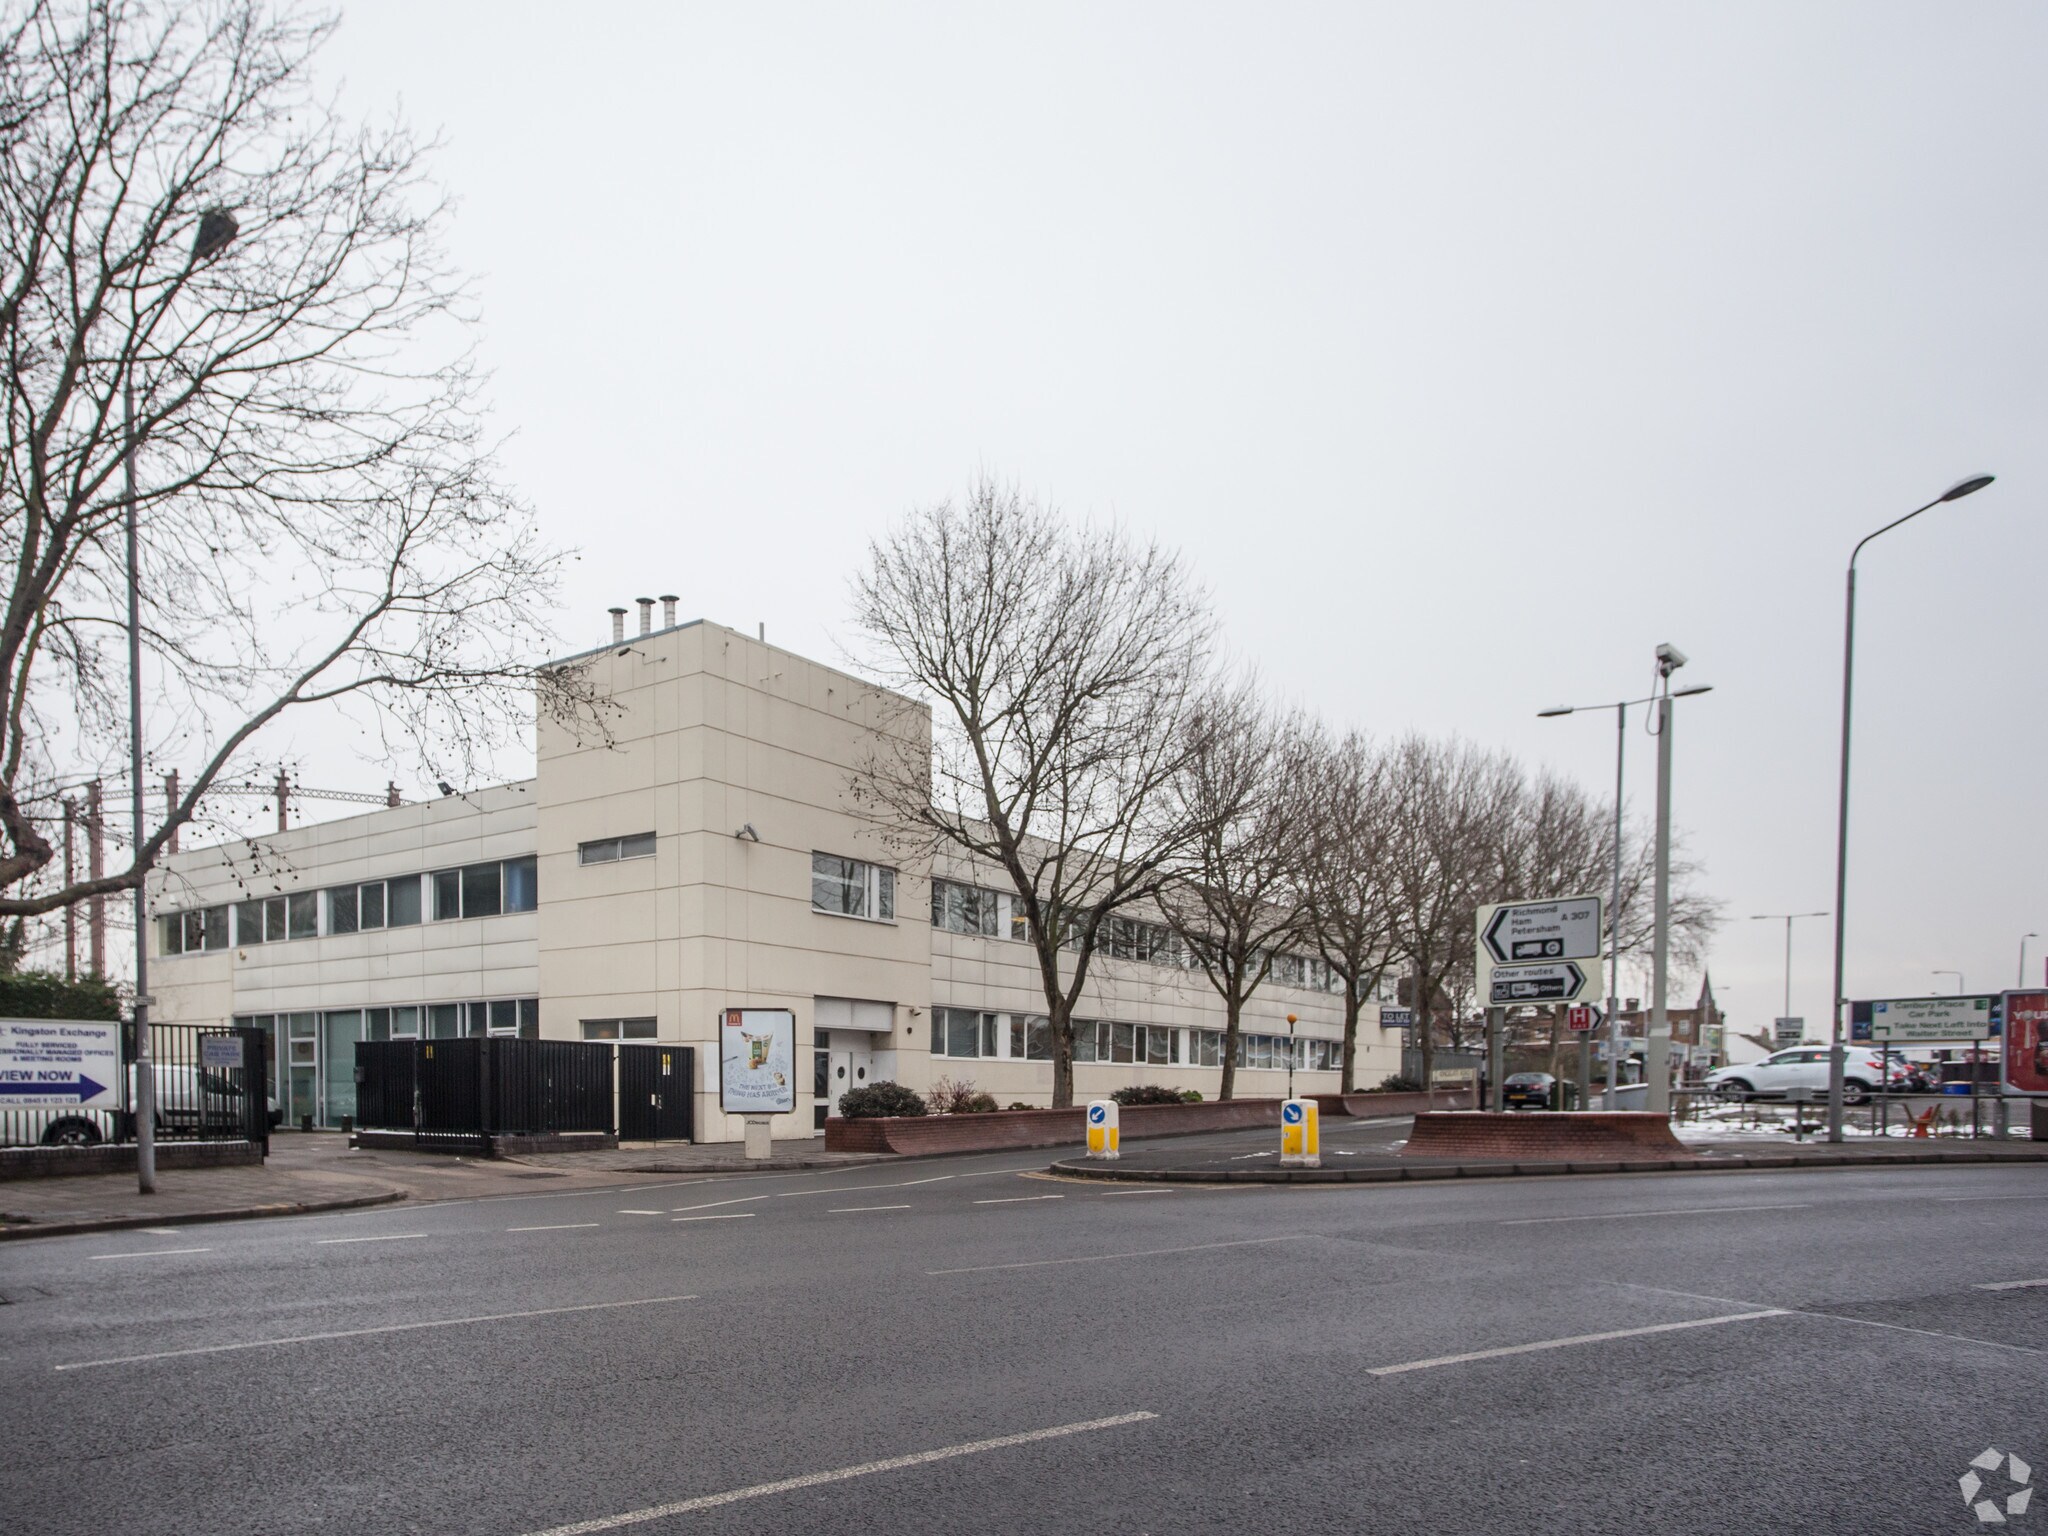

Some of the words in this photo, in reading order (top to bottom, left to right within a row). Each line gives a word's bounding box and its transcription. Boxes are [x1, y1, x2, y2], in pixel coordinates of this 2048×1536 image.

[1512, 906, 1558, 916] Richmond
[1561, 913, 1568, 921] A
[1570, 911, 1590, 920] 307
[1512, 918, 1532, 926] Ham
[1511, 925, 1561, 935] Petersham
[1493, 969, 1519, 978] Other
[1523, 968, 1554, 976] routes
[1572, 1009, 1586, 1023] H
[11, 1026, 56, 1037] Kingston
[60, 1028, 107, 1038] Exchange
[38, 1071, 72, 1081] NOW
